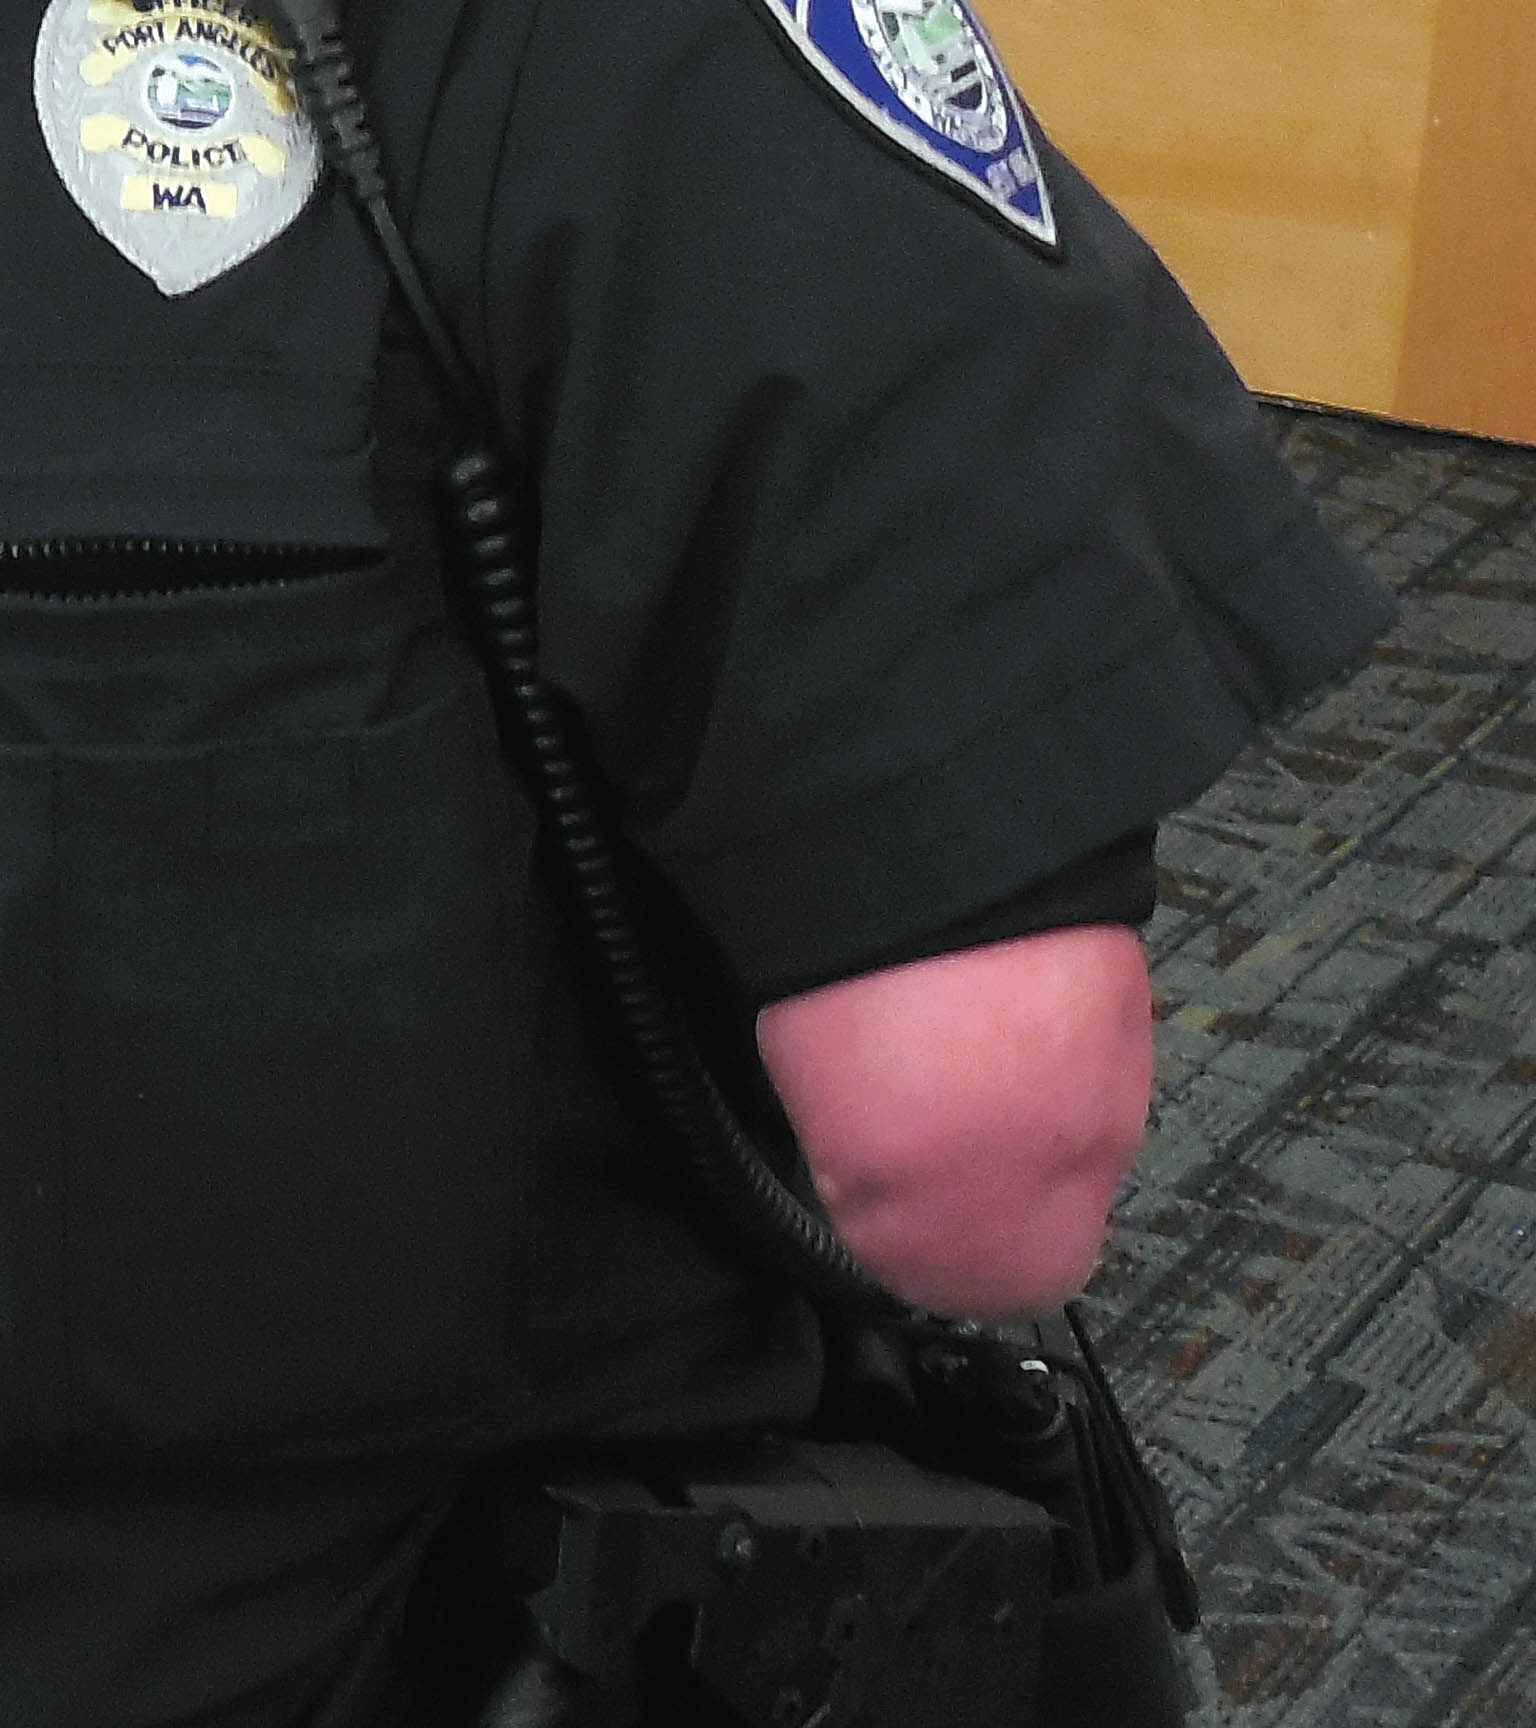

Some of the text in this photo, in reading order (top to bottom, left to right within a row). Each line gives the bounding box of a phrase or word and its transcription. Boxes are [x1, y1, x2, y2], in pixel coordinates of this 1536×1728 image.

[102, 19, 166, 56] PORT
[121, 126, 247, 168] POLICE
[152, 181, 207, 214] WA
